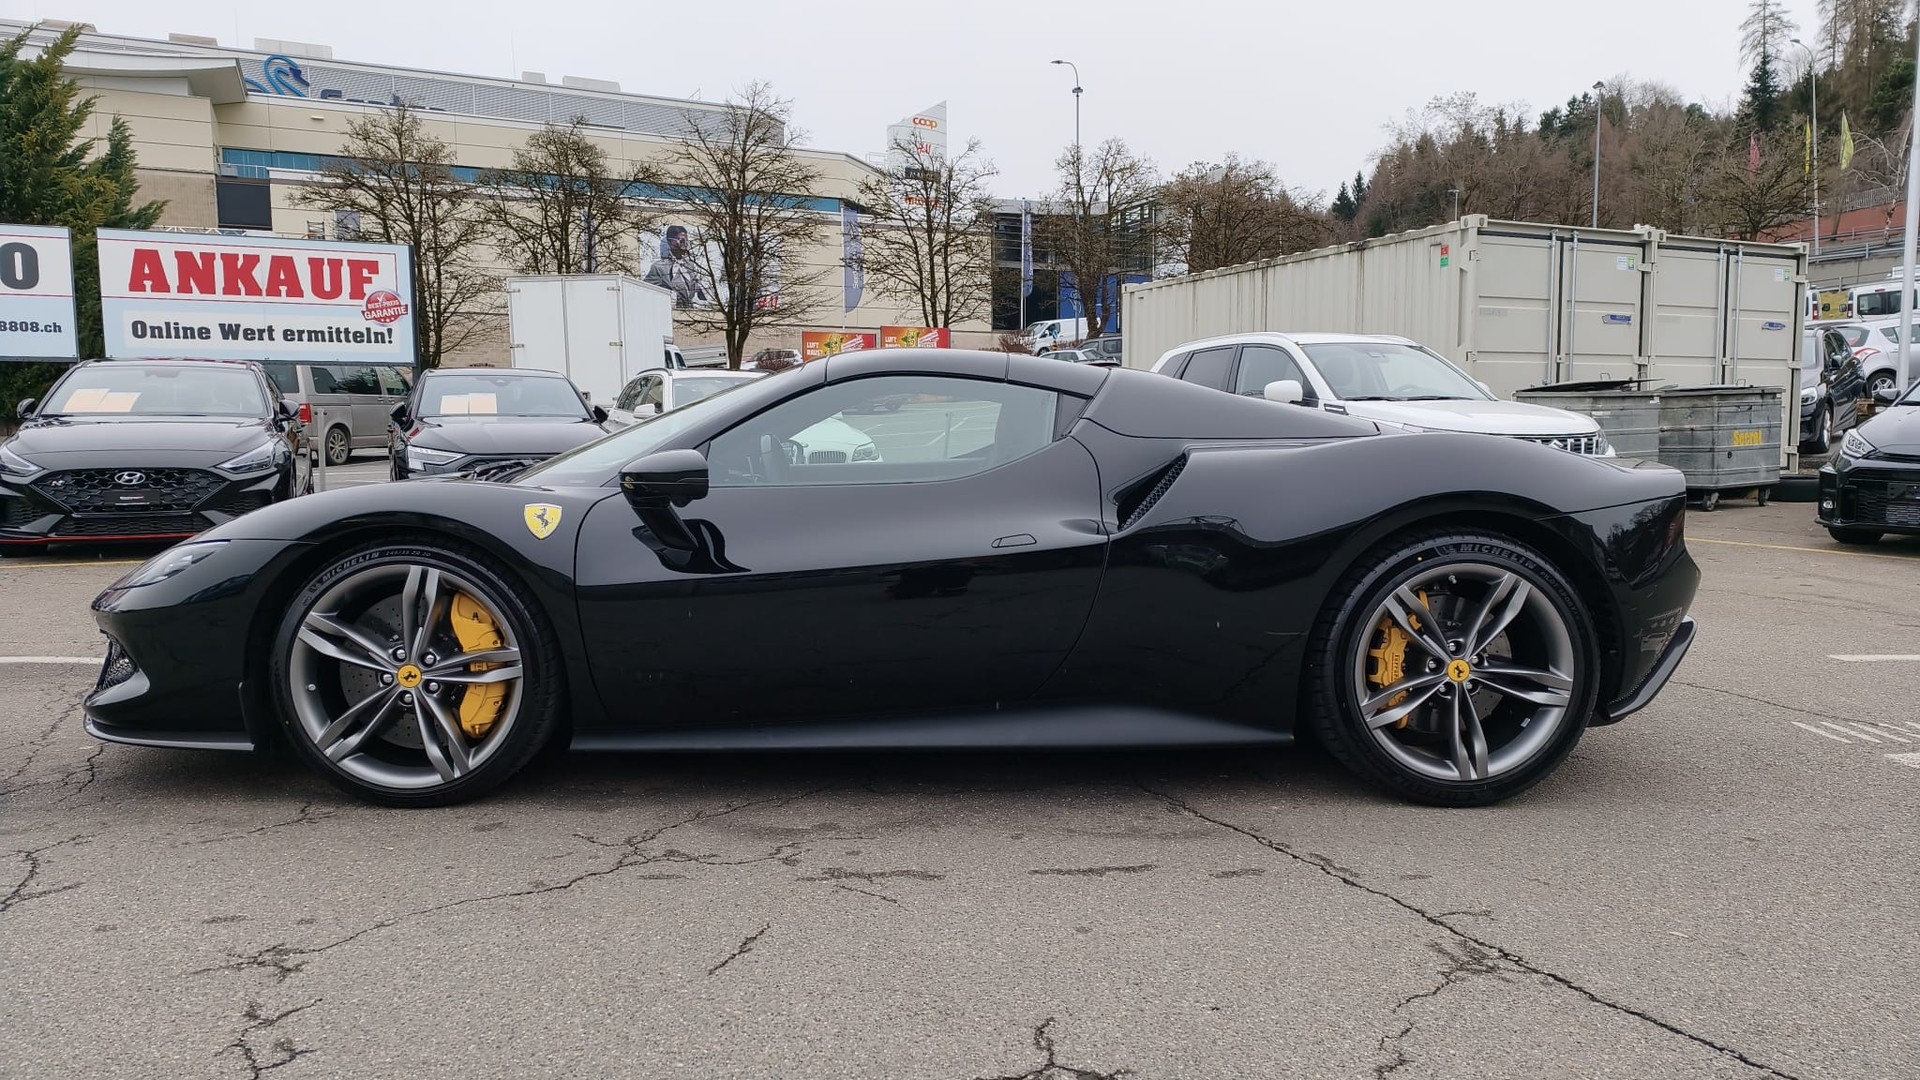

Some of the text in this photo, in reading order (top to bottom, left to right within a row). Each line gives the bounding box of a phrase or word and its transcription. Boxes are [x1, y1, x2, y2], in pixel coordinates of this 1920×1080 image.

[912, 117, 938, 129] coop
[128, 248, 380, 300] ANKAUF
[364, 305, 407, 319] GARANTIE
[0, 320, 63, 333] 8808.ch
[132, 320, 394, 345] Online Wert ermitteln!
[806, 341, 820, 349] LUFT
[1460, 543, 1537, 570] MICHELIN
[321, 551, 380, 582] MICHELIN
